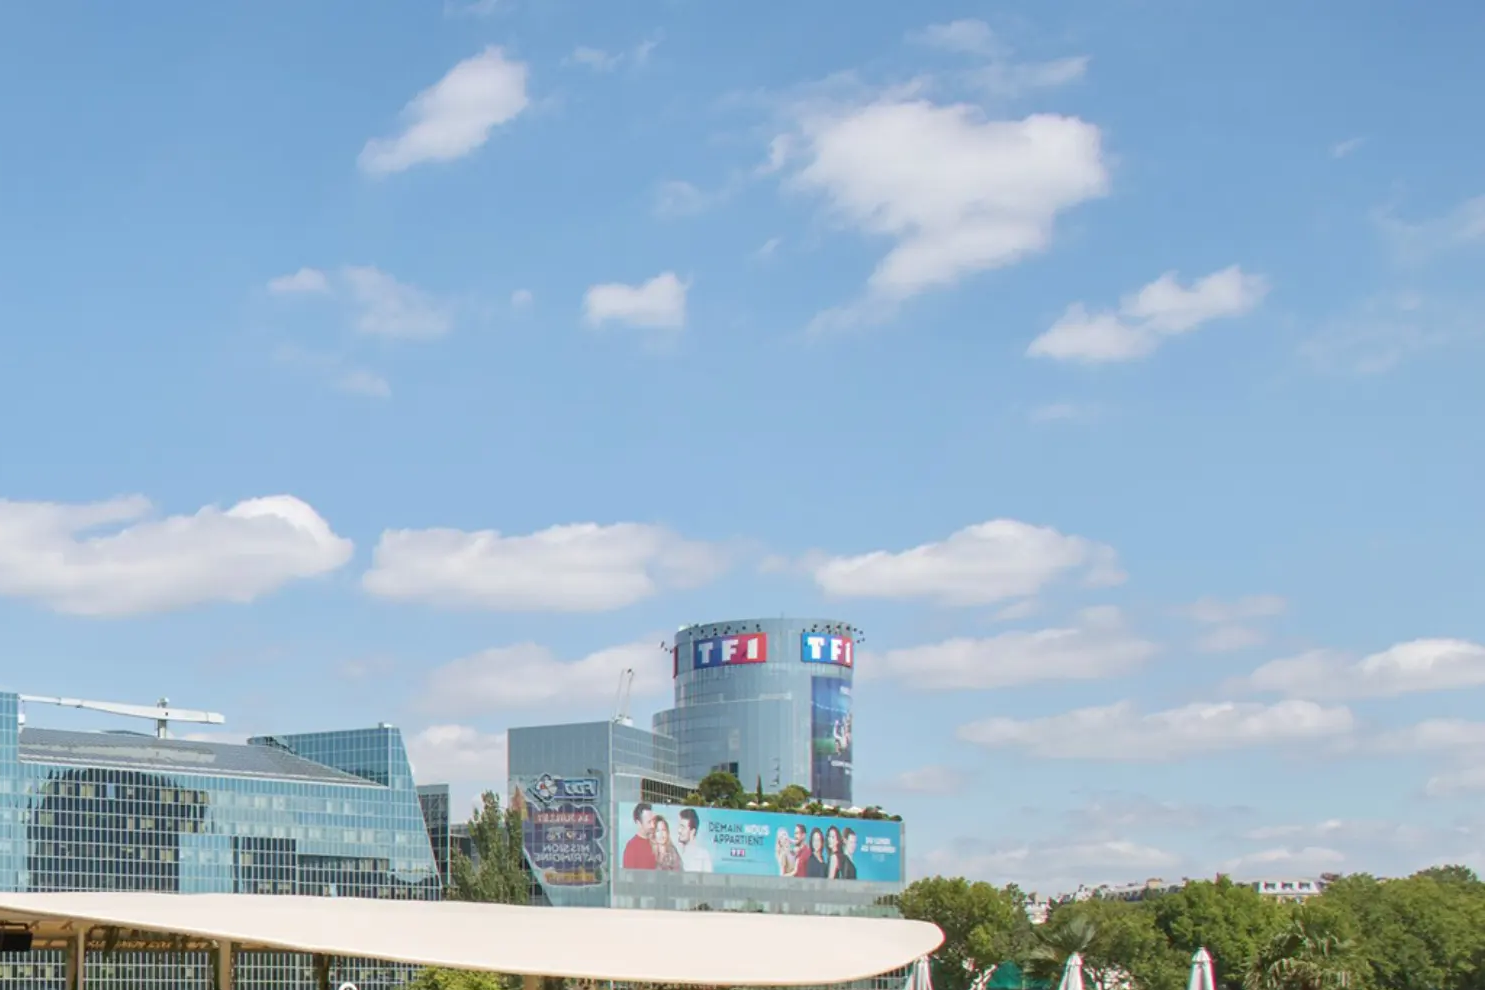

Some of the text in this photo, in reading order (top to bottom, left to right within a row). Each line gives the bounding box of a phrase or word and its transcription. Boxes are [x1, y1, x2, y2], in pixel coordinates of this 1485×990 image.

[698, 638, 759, 664] TF1
[807, 637, 851, 663] TF1
[708, 822, 743, 833] DEMAIN
[713, 834, 764, 846] APPARTIENT
